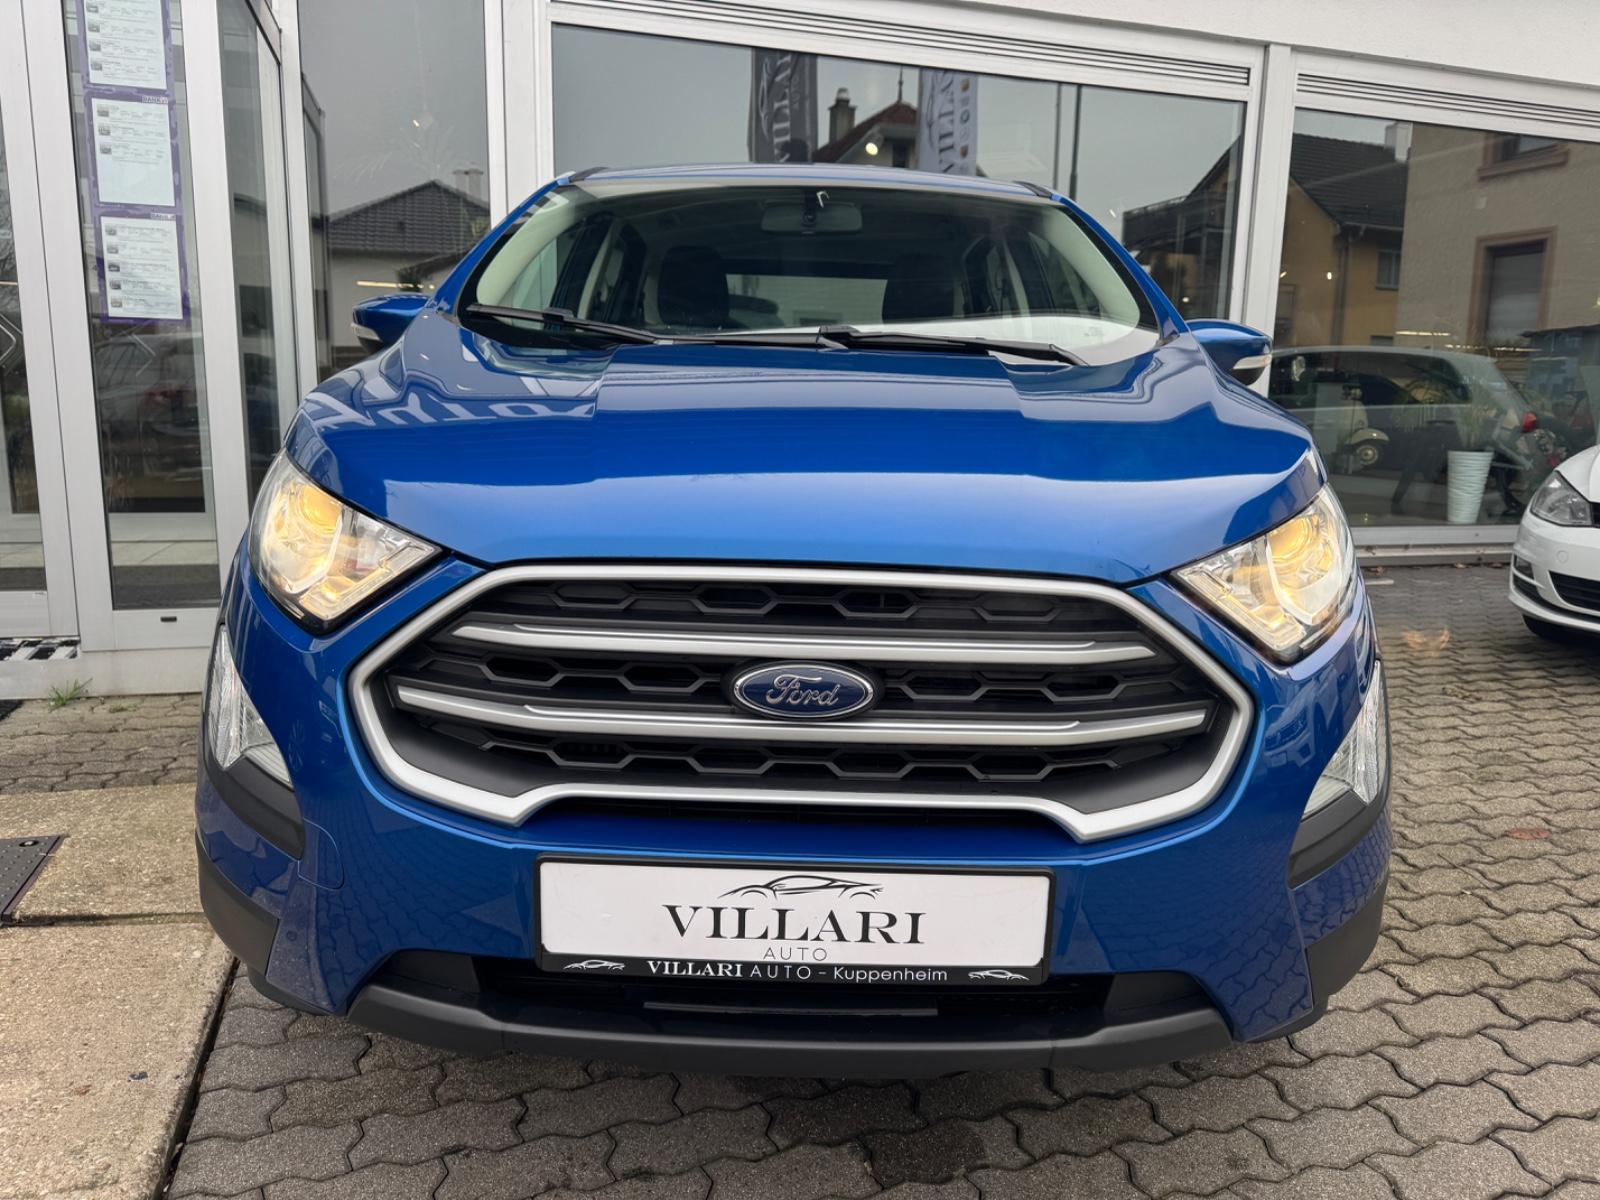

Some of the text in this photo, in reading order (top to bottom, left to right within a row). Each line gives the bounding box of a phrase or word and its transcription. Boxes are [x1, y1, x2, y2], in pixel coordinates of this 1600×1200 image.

[938, 71, 954, 173] VILLA
[766, 674, 840, 705] Ford
[662, 904, 926, 945] VILLARI
[763, 947, 828, 962] AUTO
[646, 960, 743, 978] VILLARI
[750, 964, 811, 980] AUTO
[834, 966, 948, 984] Kuppenheim
